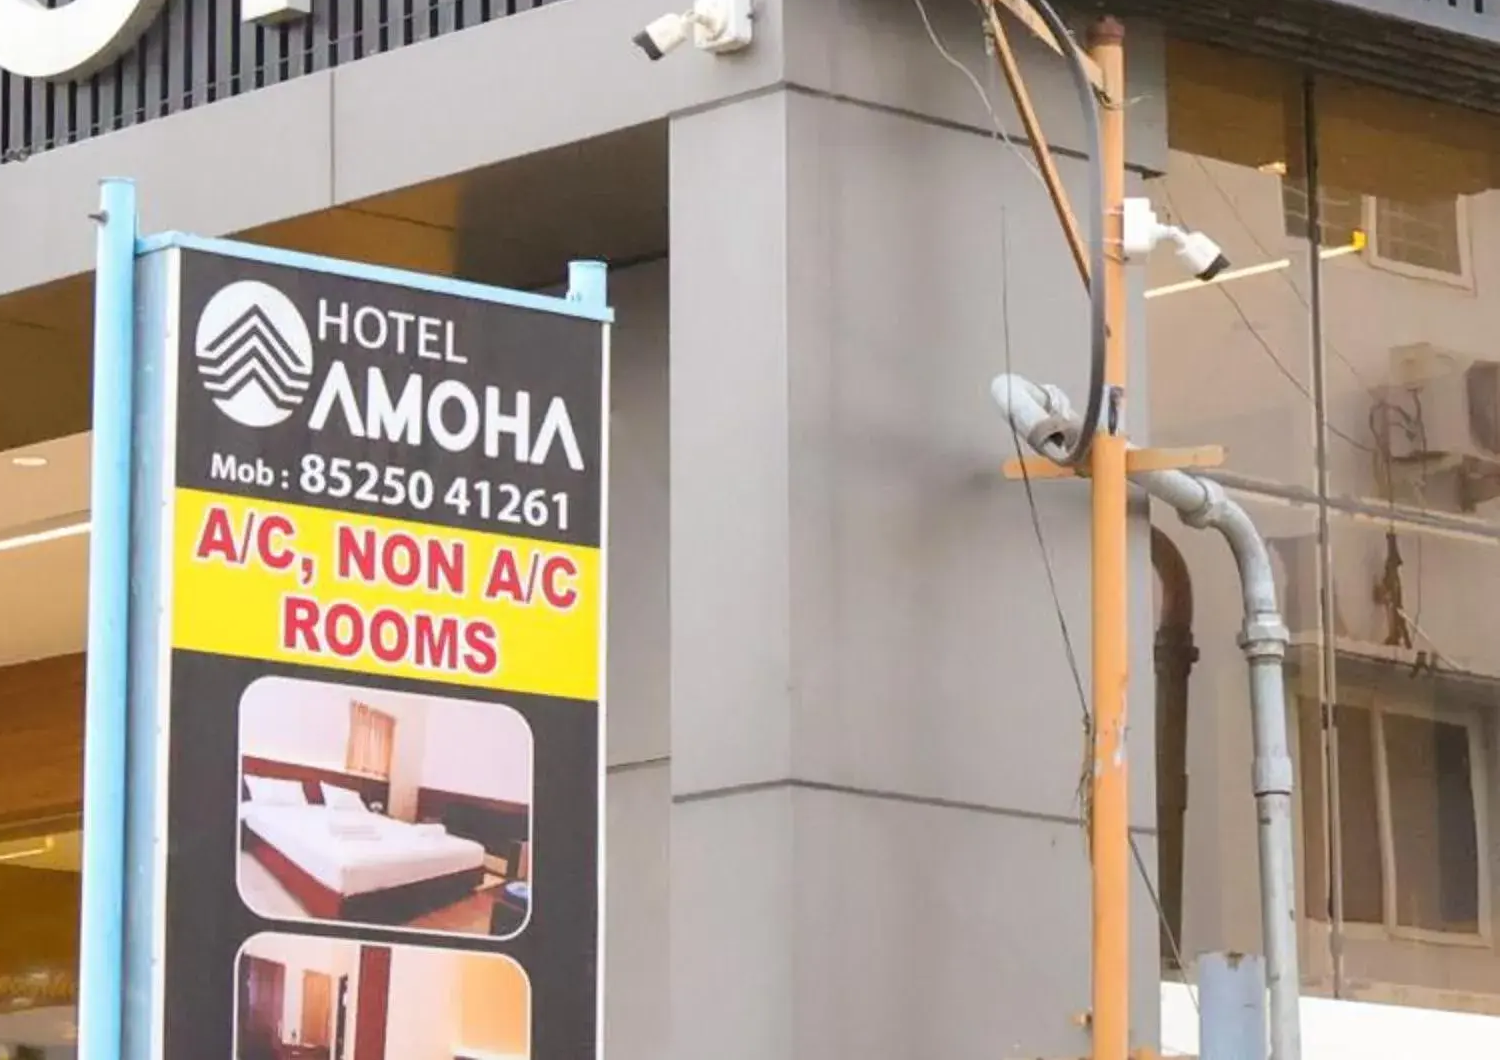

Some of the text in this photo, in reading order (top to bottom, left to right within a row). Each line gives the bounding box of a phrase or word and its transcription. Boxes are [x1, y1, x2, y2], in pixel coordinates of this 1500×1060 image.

[317, 299, 468, 364] HOTEL
[308, 360, 585, 471] AMOHA
[300, 453, 434, 510] 85250
[444, 476, 569, 530] 41261
[196, 507, 579, 609] A/C, NON A/C
[282, 597, 498, 675] ROOMS
